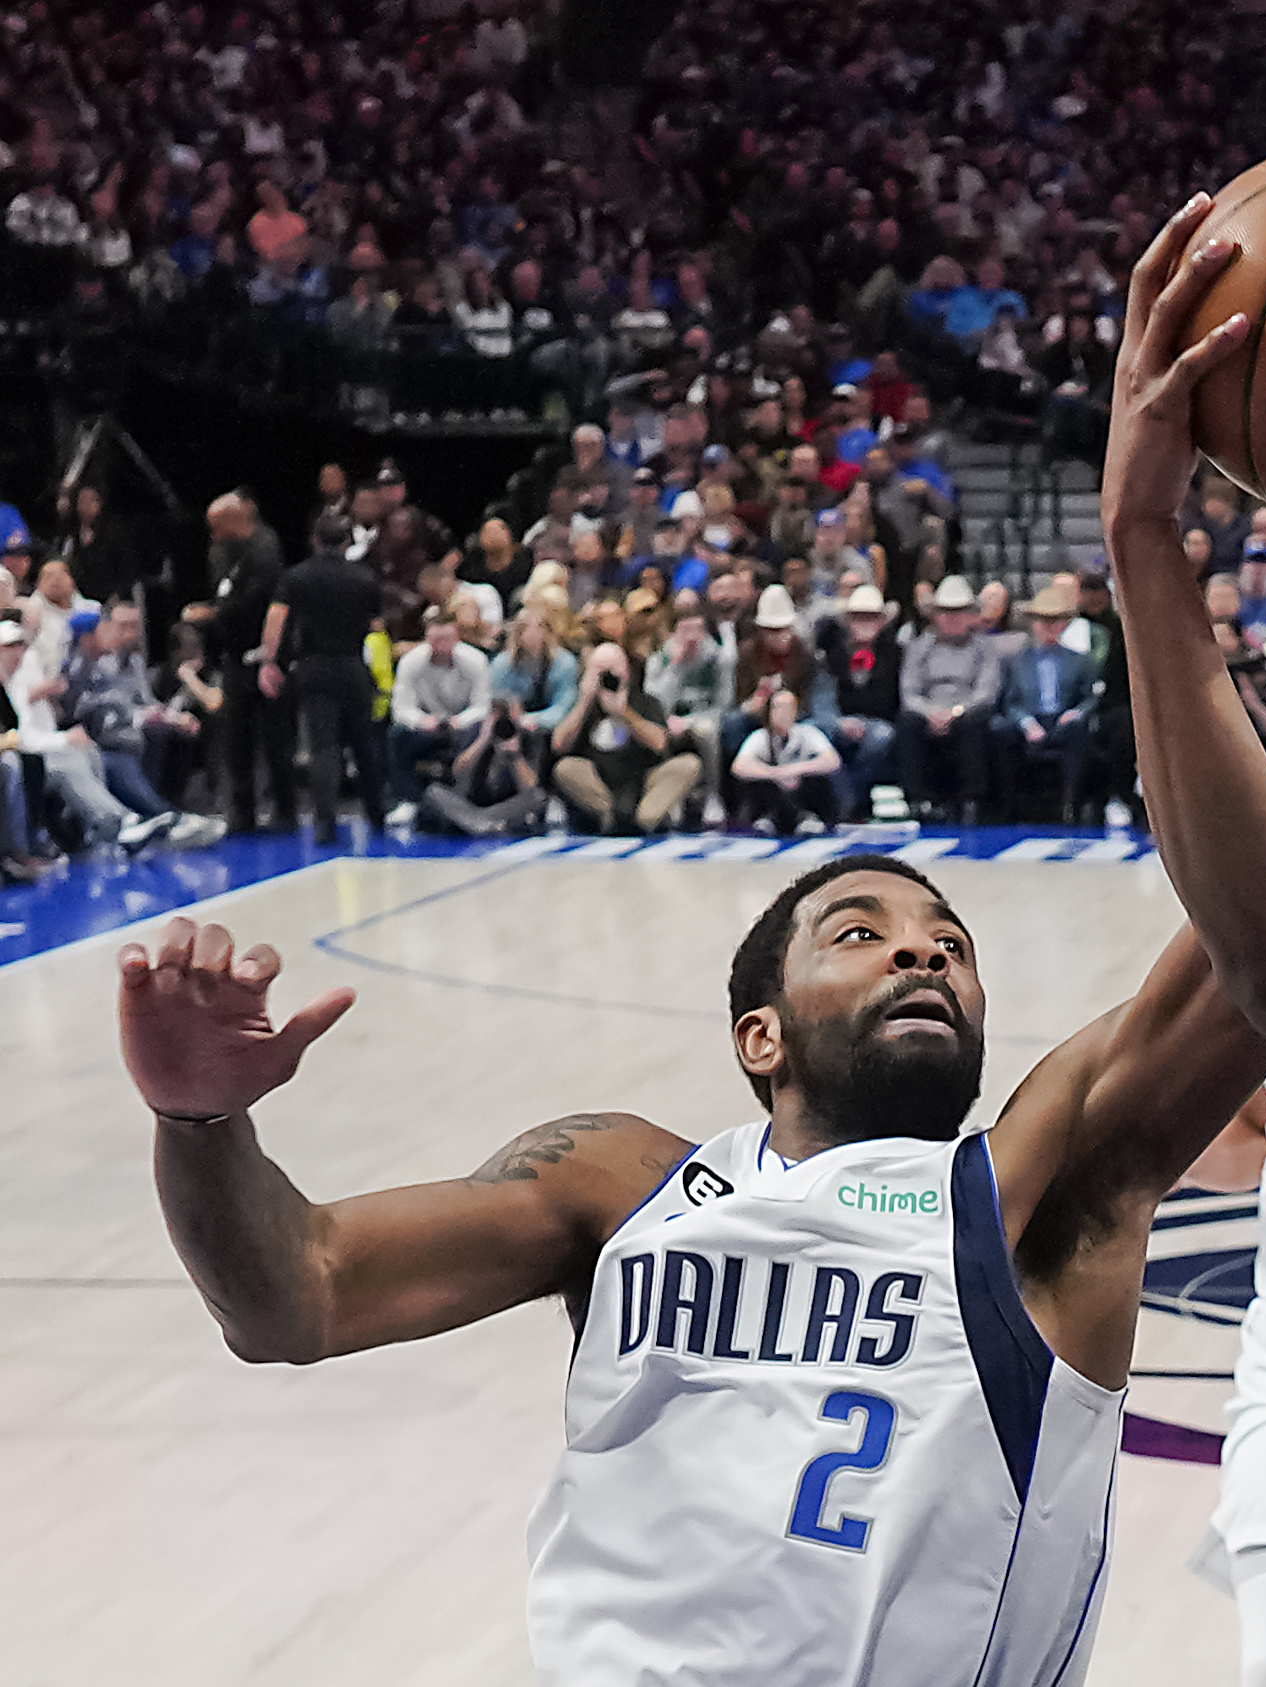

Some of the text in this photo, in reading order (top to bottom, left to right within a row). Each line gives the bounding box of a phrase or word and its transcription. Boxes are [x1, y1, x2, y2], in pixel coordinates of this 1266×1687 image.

[837, 1183, 939, 1214] chime
[617, 1249, 929, 1371] DALLAS
[784, 1388, 898, 1554] 2
